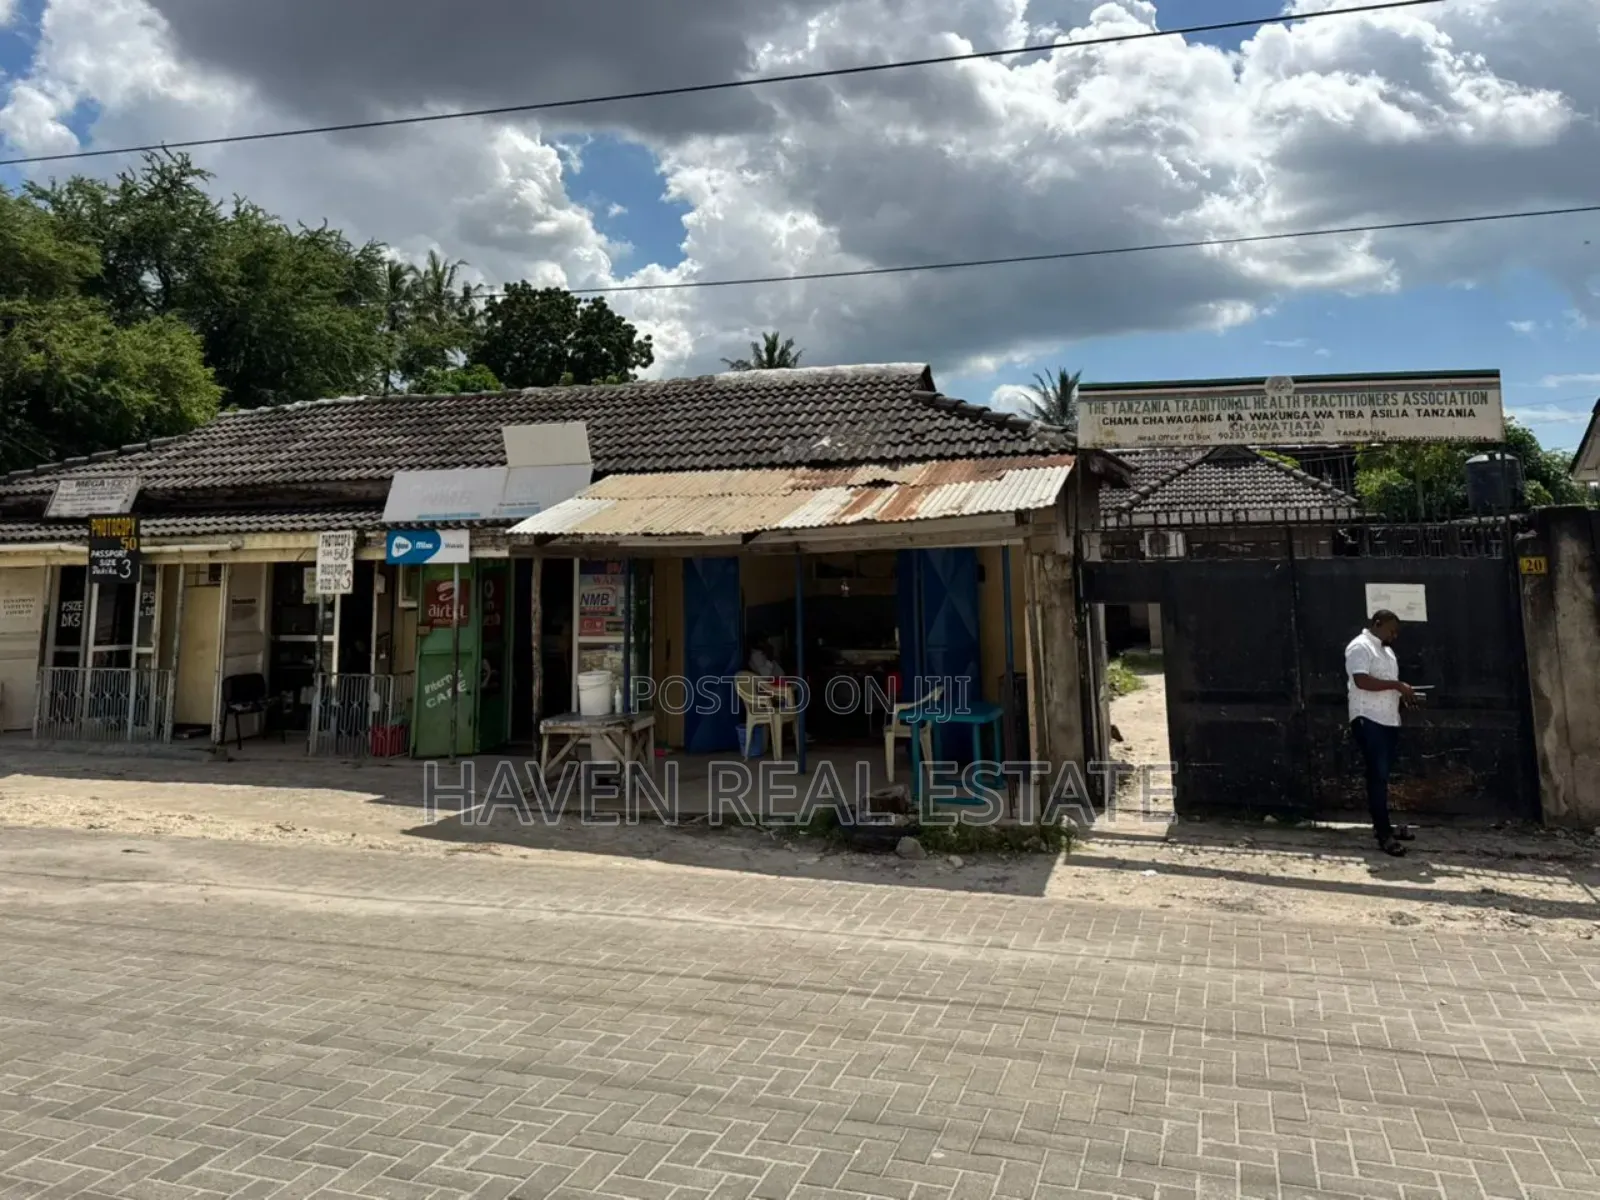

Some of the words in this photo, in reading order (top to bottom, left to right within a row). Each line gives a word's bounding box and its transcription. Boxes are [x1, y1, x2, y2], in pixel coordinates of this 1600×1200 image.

[1088, 401, 1108, 415] THE
[1112, 399, 1170, 415] TANZANIA
[1175, 397, 1250, 413] TRADITIONAL
[1253, 395, 1300, 410] HEALTH
[1304, 392, 1398, 408] PRACTITIONERS
[1403, 391, 1489, 406] ASSOCIATION
[1102, 416, 1139, 426] CHAMA
[1142, 414, 1165, 425] CHA
[1167, 412, 1223, 425] WAGANGA
[1228, 411, 1243, 421] NA
[1249, 410, 1310, 421] WAKUNGA
[1313, 409, 1335, 420] WA
[1339, 408, 1365, 420] TIBA
[1371, 407, 1409, 419] ASILIA
[1416, 407, 1476, 419] TANZANIA
[1336, 429, 1387, 437] TANZANIA
[120, 536, 137, 550] 50
[90, 550, 127, 559] PASSPORT
[99, 558, 117, 566] SIZE
[119, 558, 131, 579] 3
[1526, 559, 1543, 572] 20
[341, 569, 352, 590] 3
[580, 593, 610, 606] NMB
[428, 604, 468, 618] airtl
